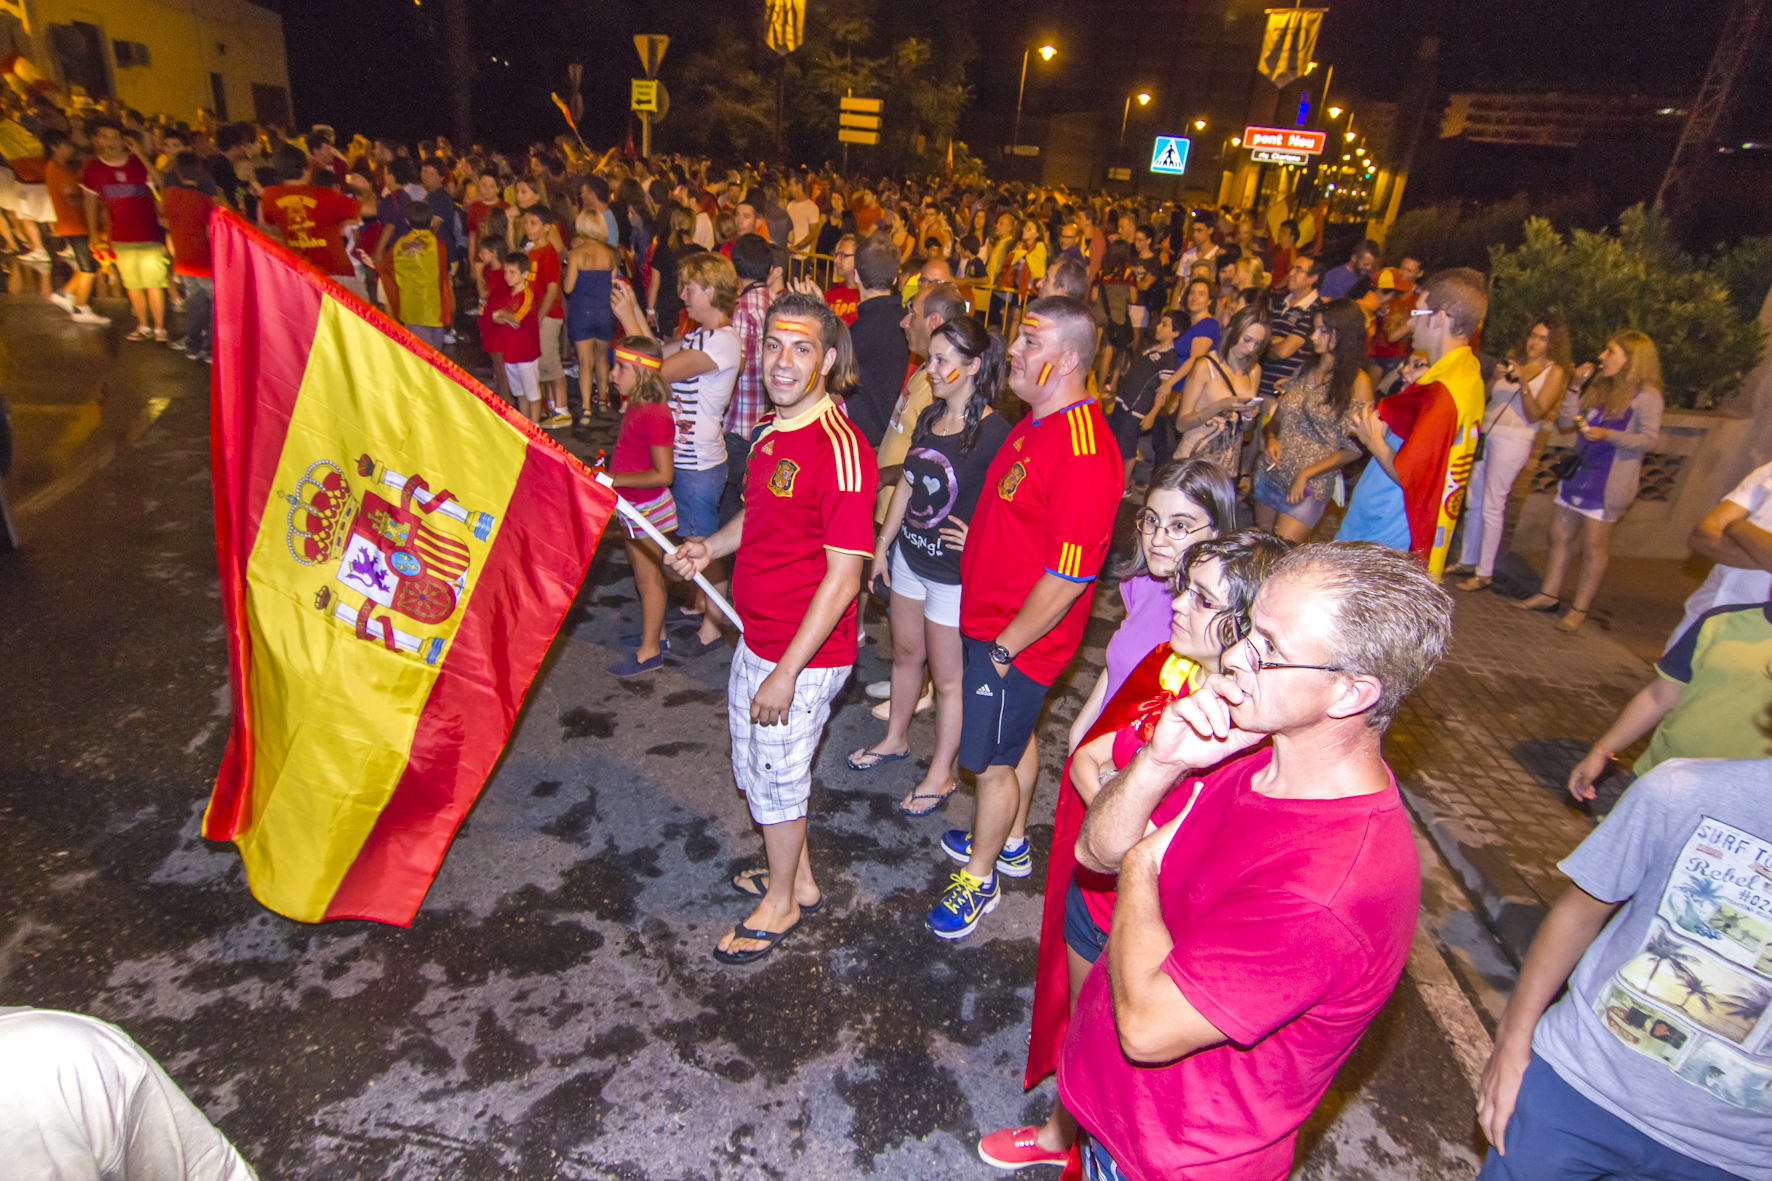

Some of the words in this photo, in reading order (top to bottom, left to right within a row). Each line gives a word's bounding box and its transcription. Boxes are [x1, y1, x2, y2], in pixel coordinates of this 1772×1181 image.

[1252, 133, 1283, 146] pont
[1288, 134, 1315, 148] Nou
[1697, 825, 1750, 854] SURF
[1685, 857, 1760, 890] Rebel
[1739, 889, 1772, 914] #02
